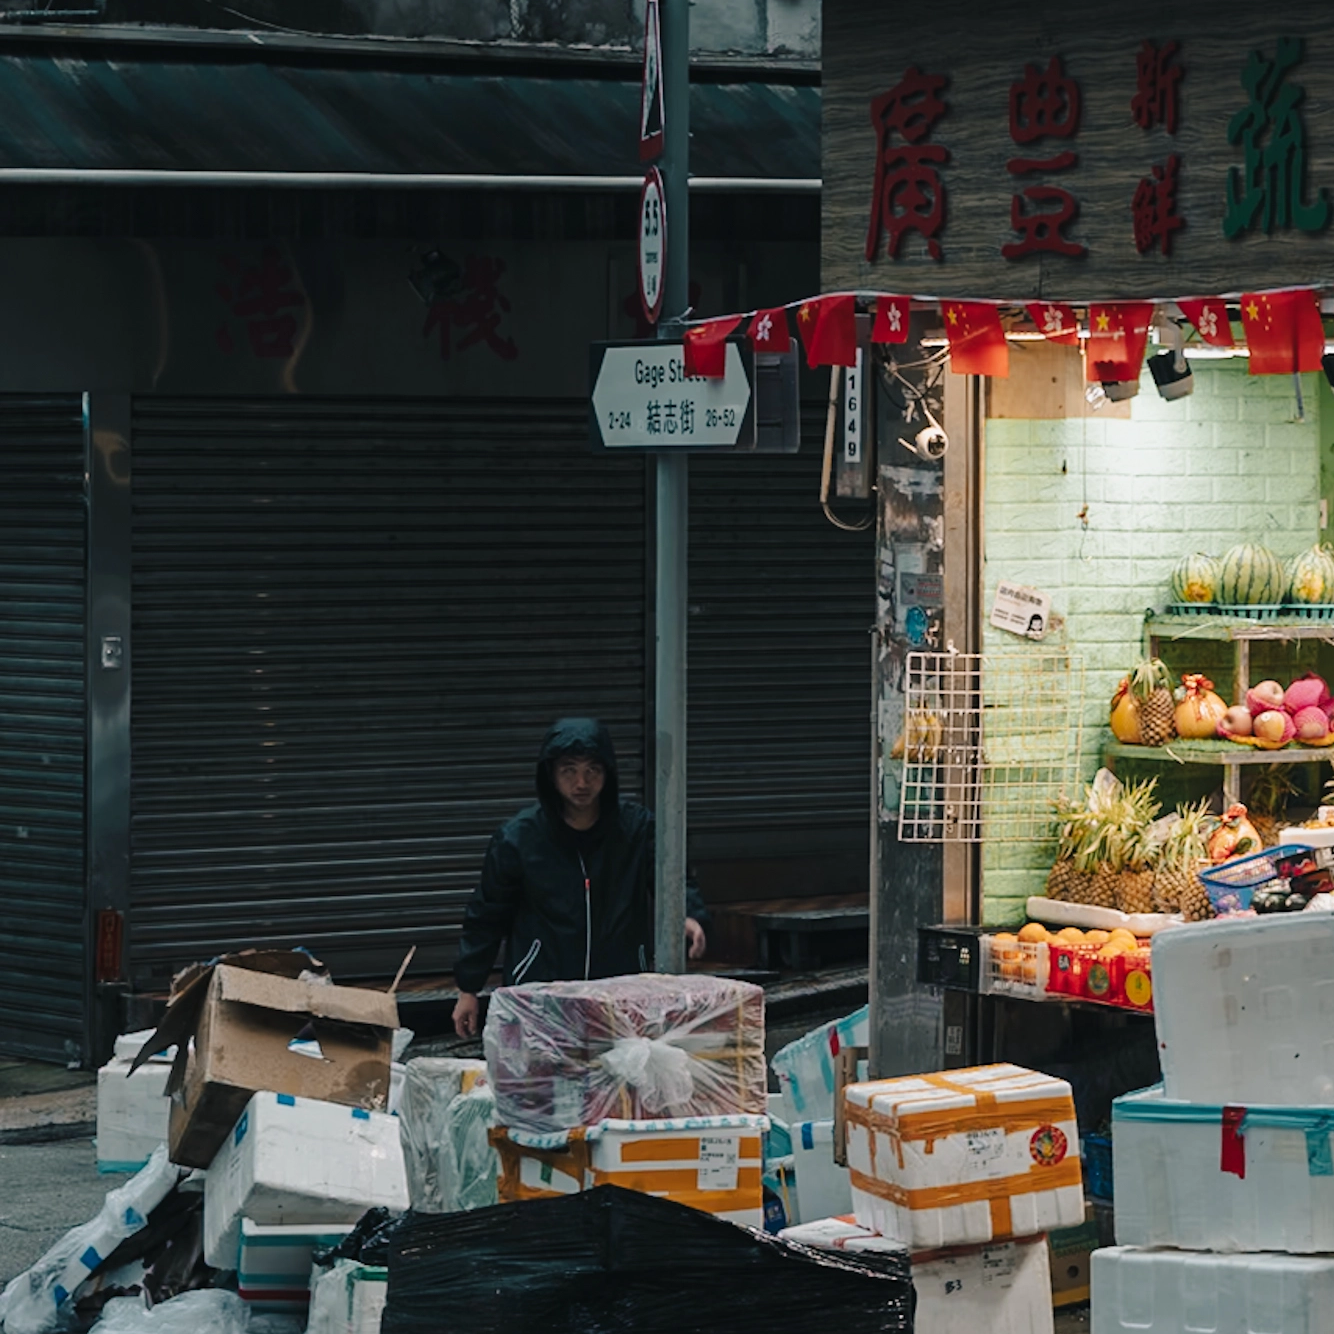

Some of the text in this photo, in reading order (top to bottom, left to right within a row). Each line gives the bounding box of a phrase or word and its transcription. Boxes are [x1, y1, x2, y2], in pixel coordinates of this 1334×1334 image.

[1131, 39, 1185, 257] 新鮮
[635, 358, 665, 389] Gage
[646, 399, 695, 435] 結志街
[848, 373, 858, 457] 1649
